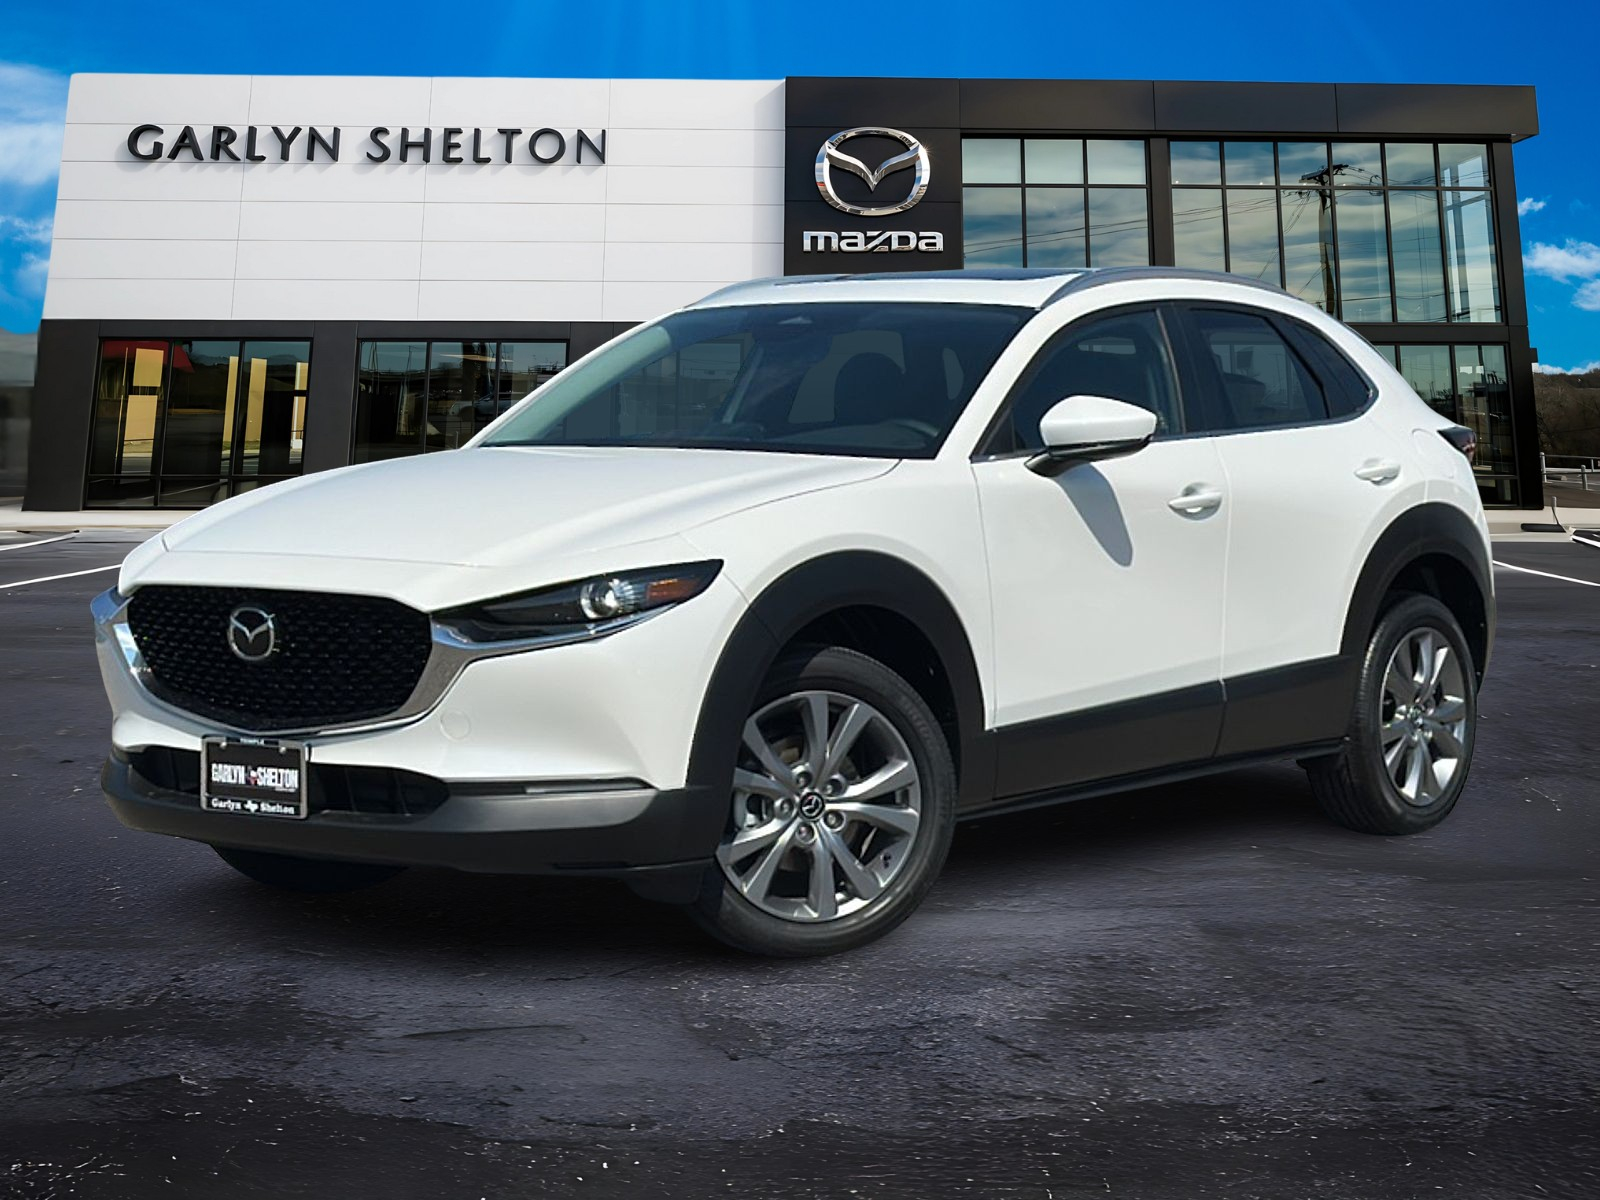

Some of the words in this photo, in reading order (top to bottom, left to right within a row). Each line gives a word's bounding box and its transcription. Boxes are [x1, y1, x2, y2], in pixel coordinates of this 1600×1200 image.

[127, 124, 341, 163] GARLYN
[366, 126, 607, 164] SHELTON
[256, 767, 299, 789] SHELTON
[260, 802, 295, 815] Shelton
